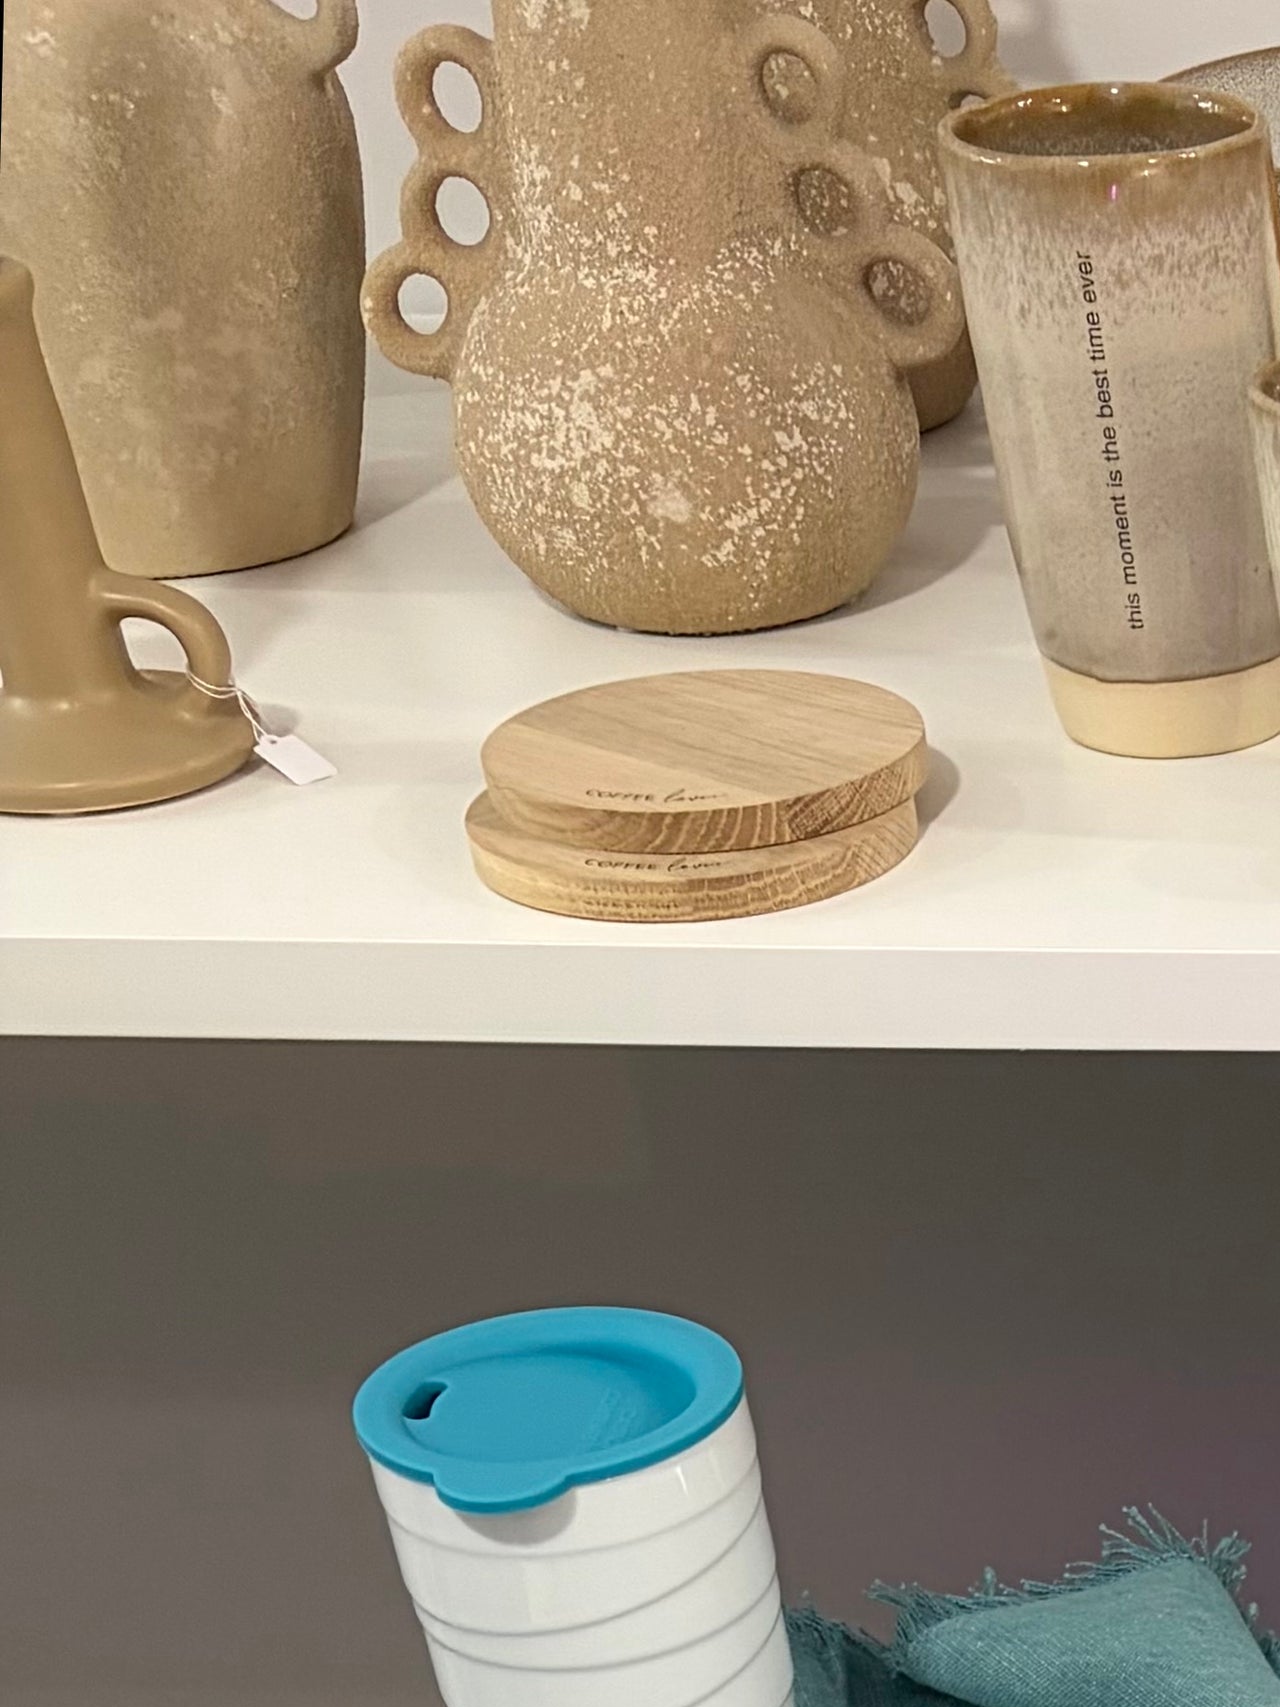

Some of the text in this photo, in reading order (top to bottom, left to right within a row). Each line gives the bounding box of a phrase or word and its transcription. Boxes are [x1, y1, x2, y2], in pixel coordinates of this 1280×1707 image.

[1076, 250, 1144, 630] this moment is the best time ever
